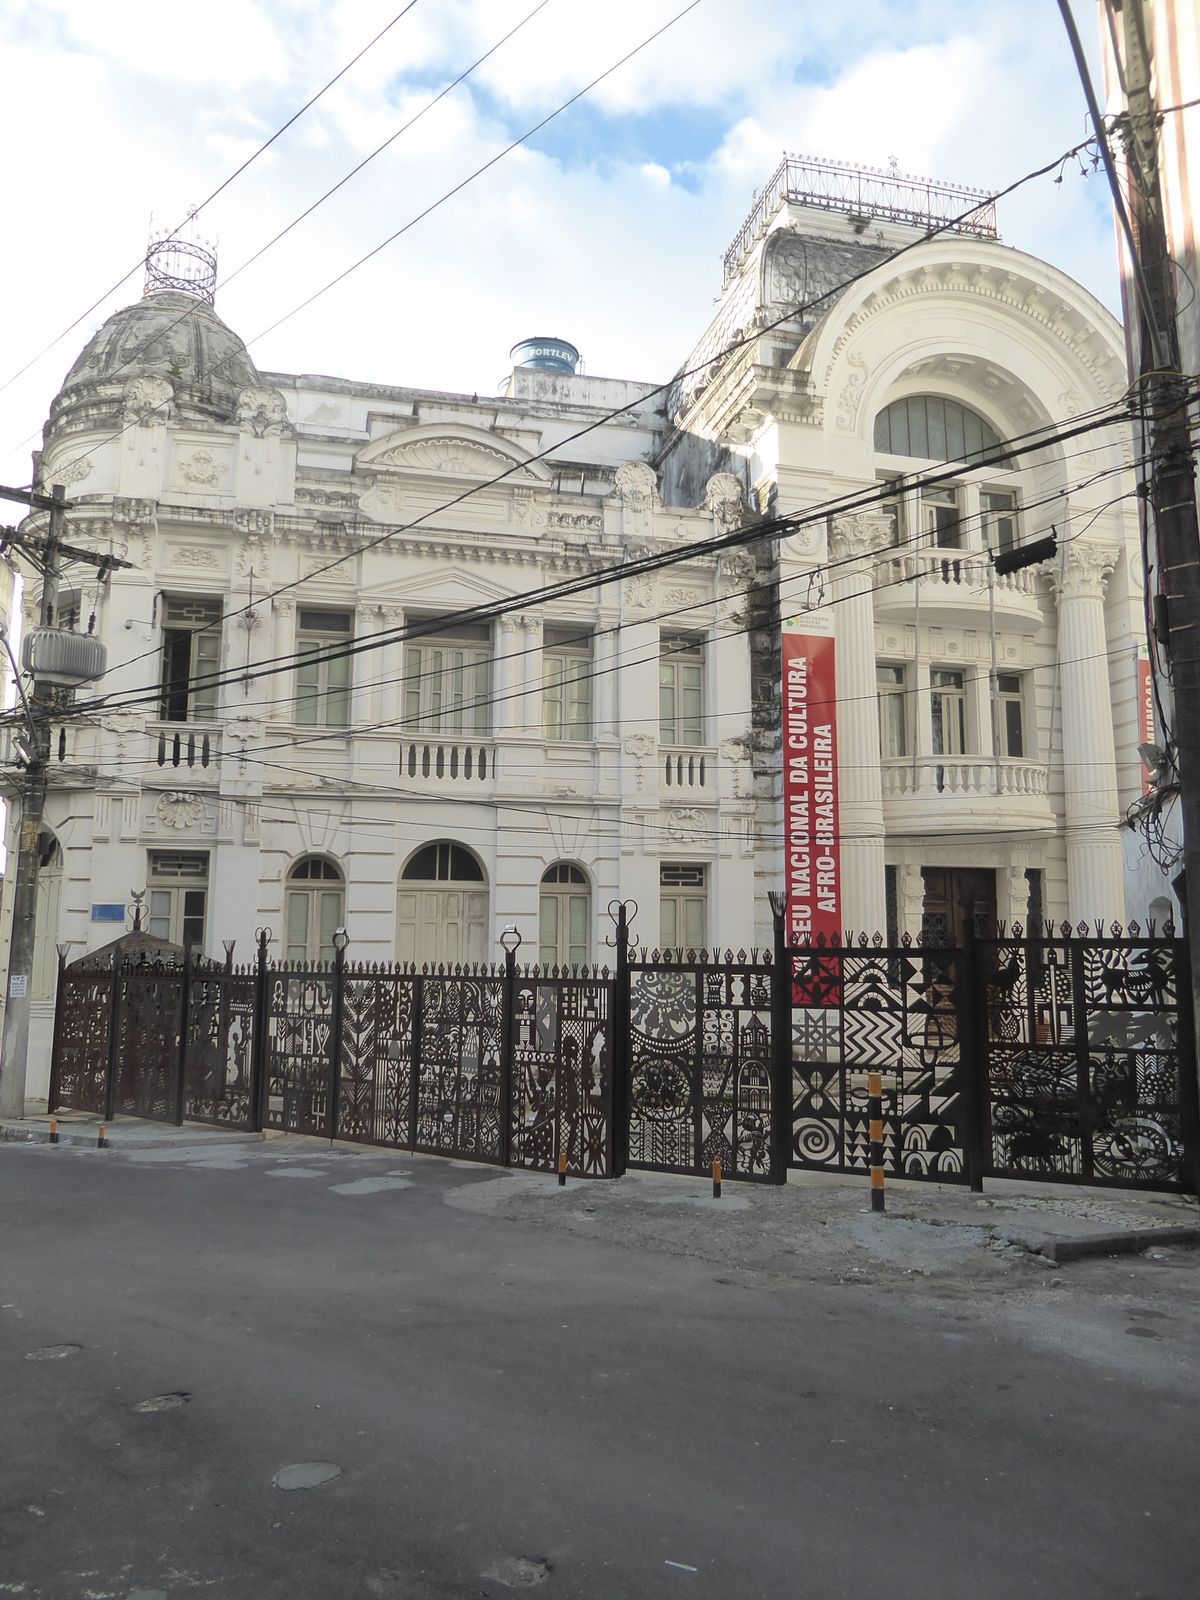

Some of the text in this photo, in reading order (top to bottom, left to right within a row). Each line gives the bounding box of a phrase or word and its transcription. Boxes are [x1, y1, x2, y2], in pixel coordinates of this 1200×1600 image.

[529, 348, 573, 361] FORTLEV
[787, 657, 808, 749] CULTURA
[789, 755, 809, 783] DA
[789, 790, 810, 896] NACIONAL
[813, 724, 836, 913] AFRO-BRASILEIRA
